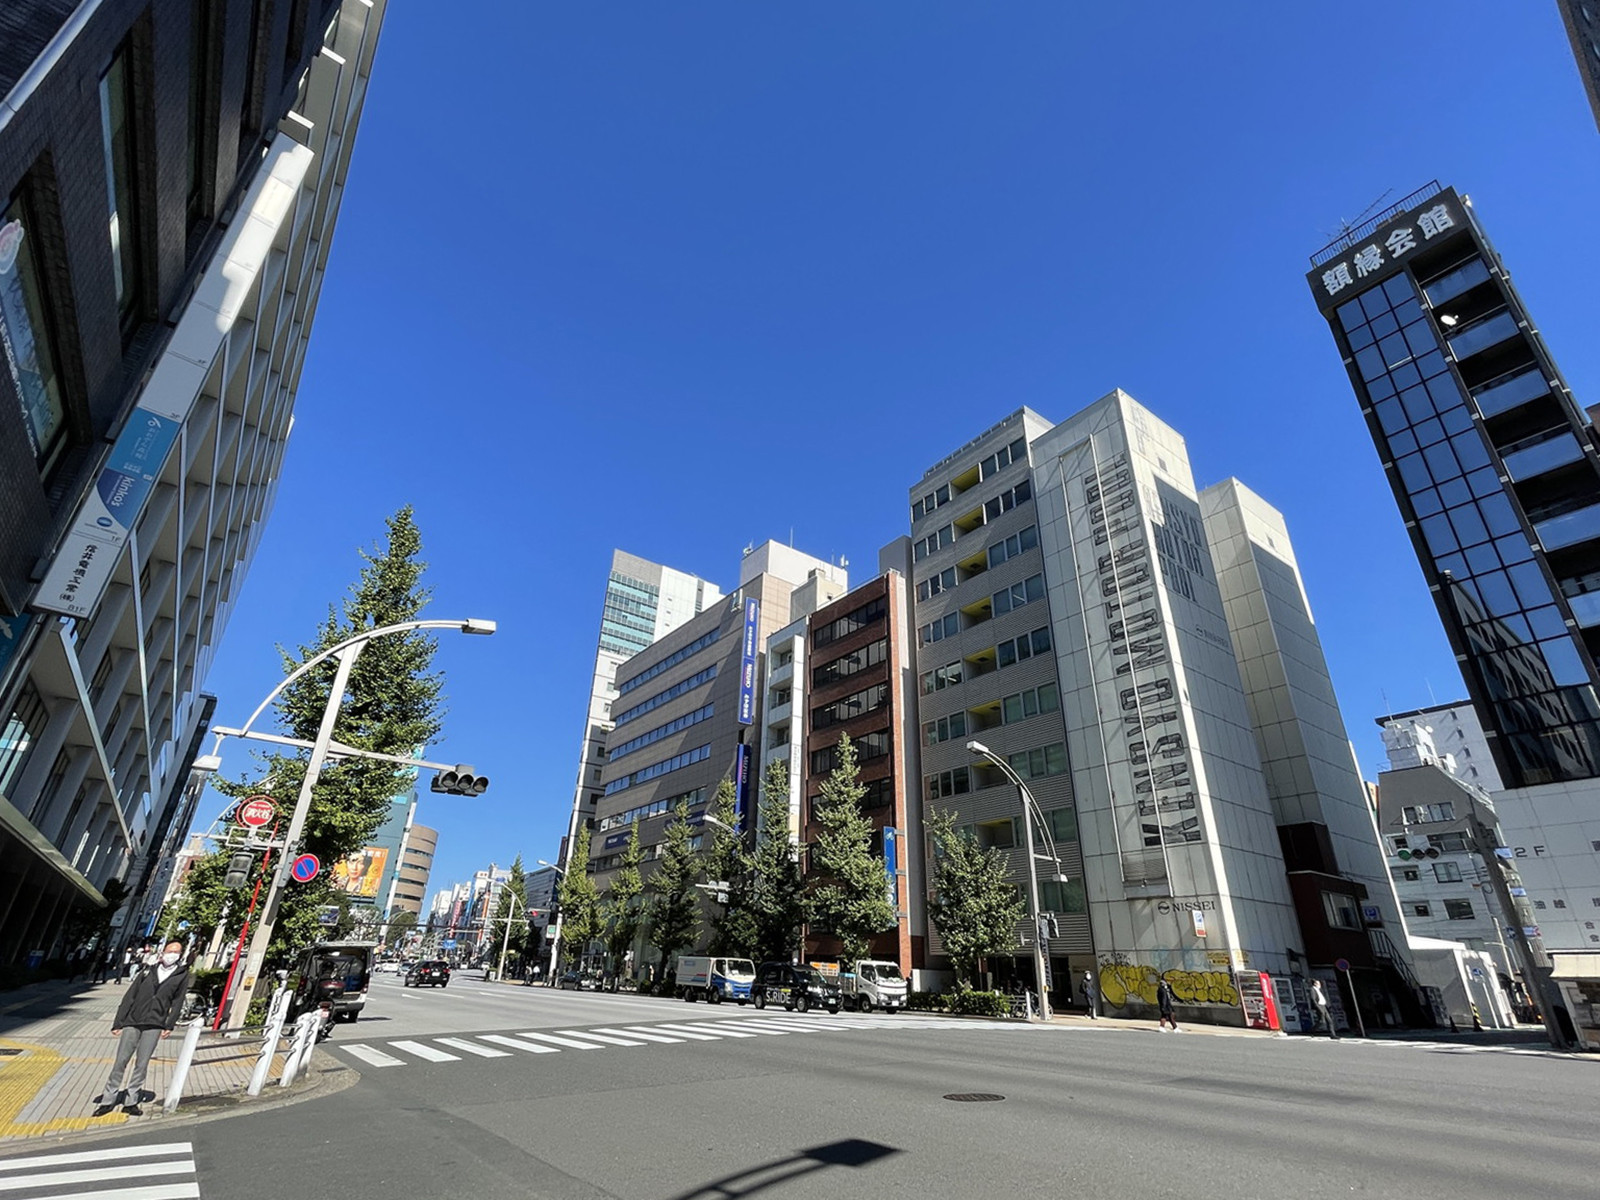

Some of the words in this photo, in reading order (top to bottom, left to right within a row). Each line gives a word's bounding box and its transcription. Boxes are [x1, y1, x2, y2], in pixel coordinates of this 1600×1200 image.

[1321, 204, 1455, 296] 額縁会館
[111, 476, 135, 507] kinko's
[1085, 451, 1140, 546] POOL
[1098, 538, 1166, 675] MOTOR
[1120, 678, 1202, 846] KENSYO
[245, 808, 271, 819] 消火栓
[1172, 901, 1216, 913] NISSEI
[765, 991, 792, 1004] S.RIDE
